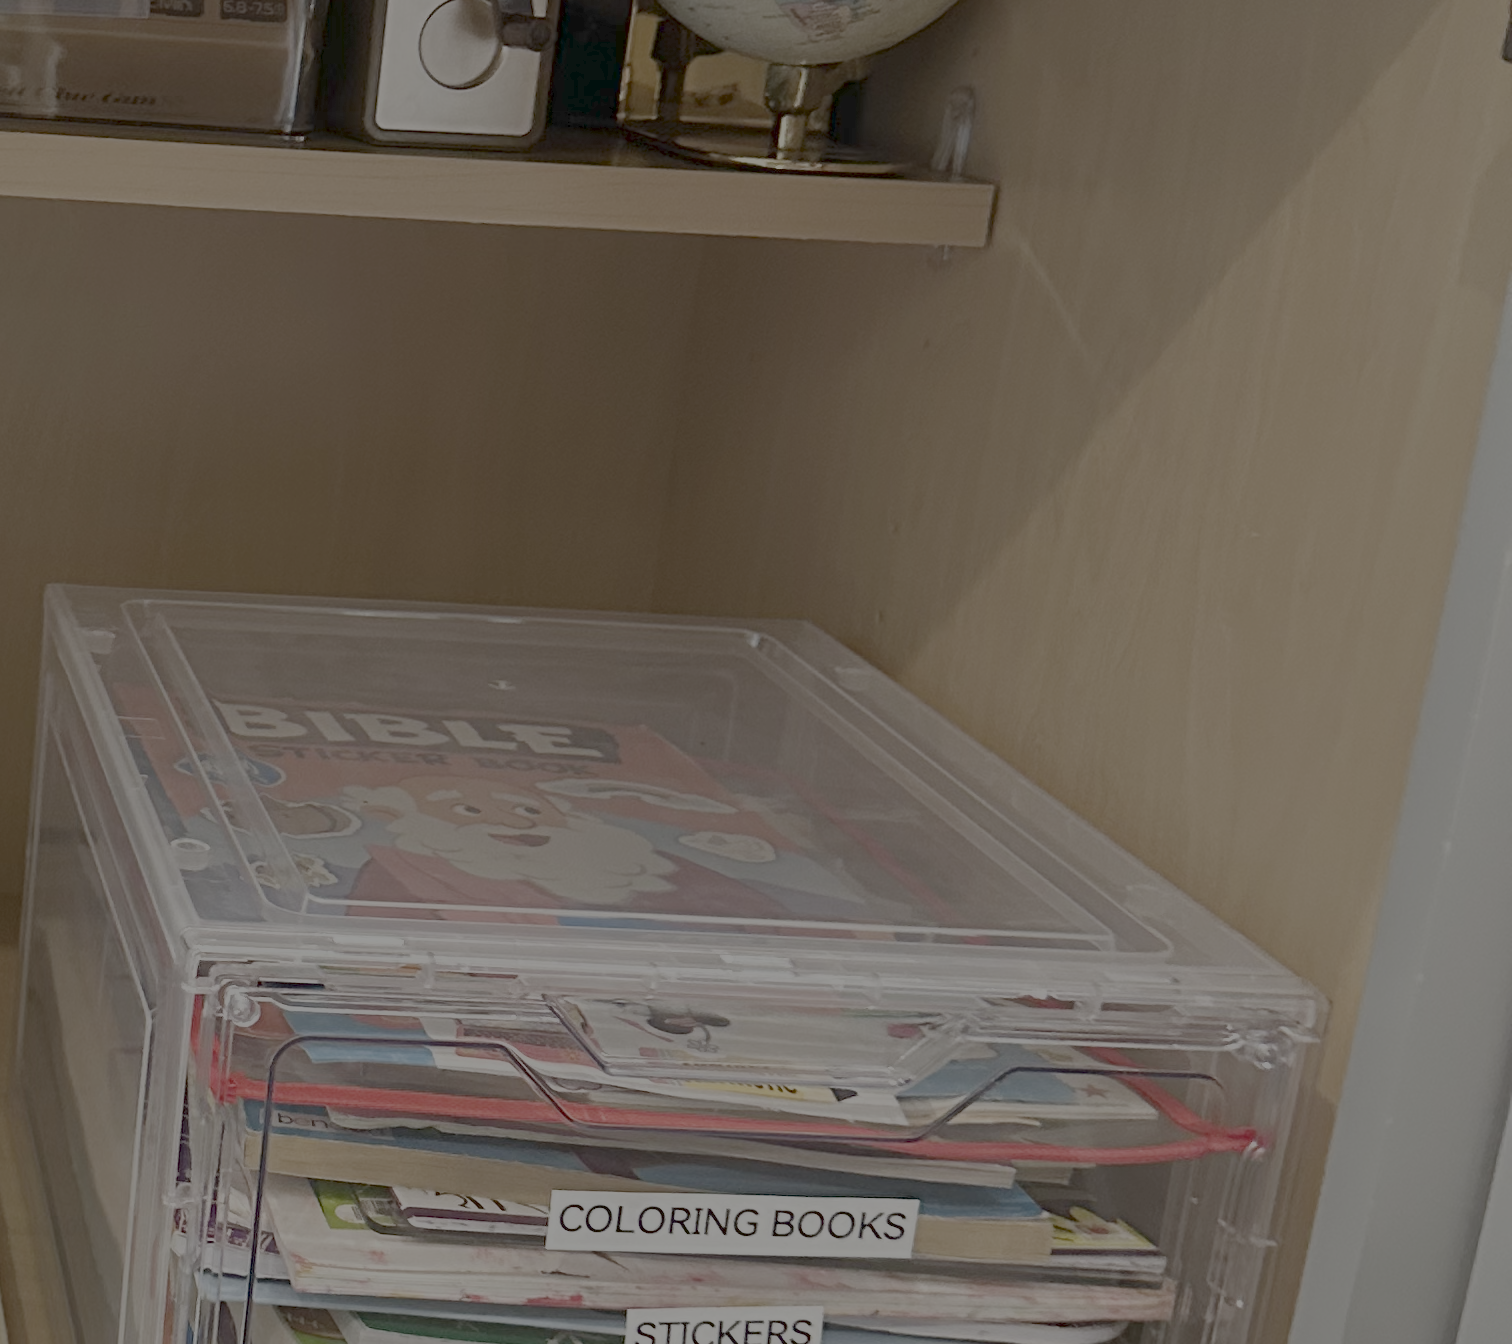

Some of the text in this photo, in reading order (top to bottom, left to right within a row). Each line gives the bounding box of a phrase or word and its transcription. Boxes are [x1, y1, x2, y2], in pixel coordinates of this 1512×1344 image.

[213, 699, 604, 758] BIBLE
[247, 743, 600, 777] STICKER BOOK
[559, 1204, 907, 1240] COLORING BOOKS
